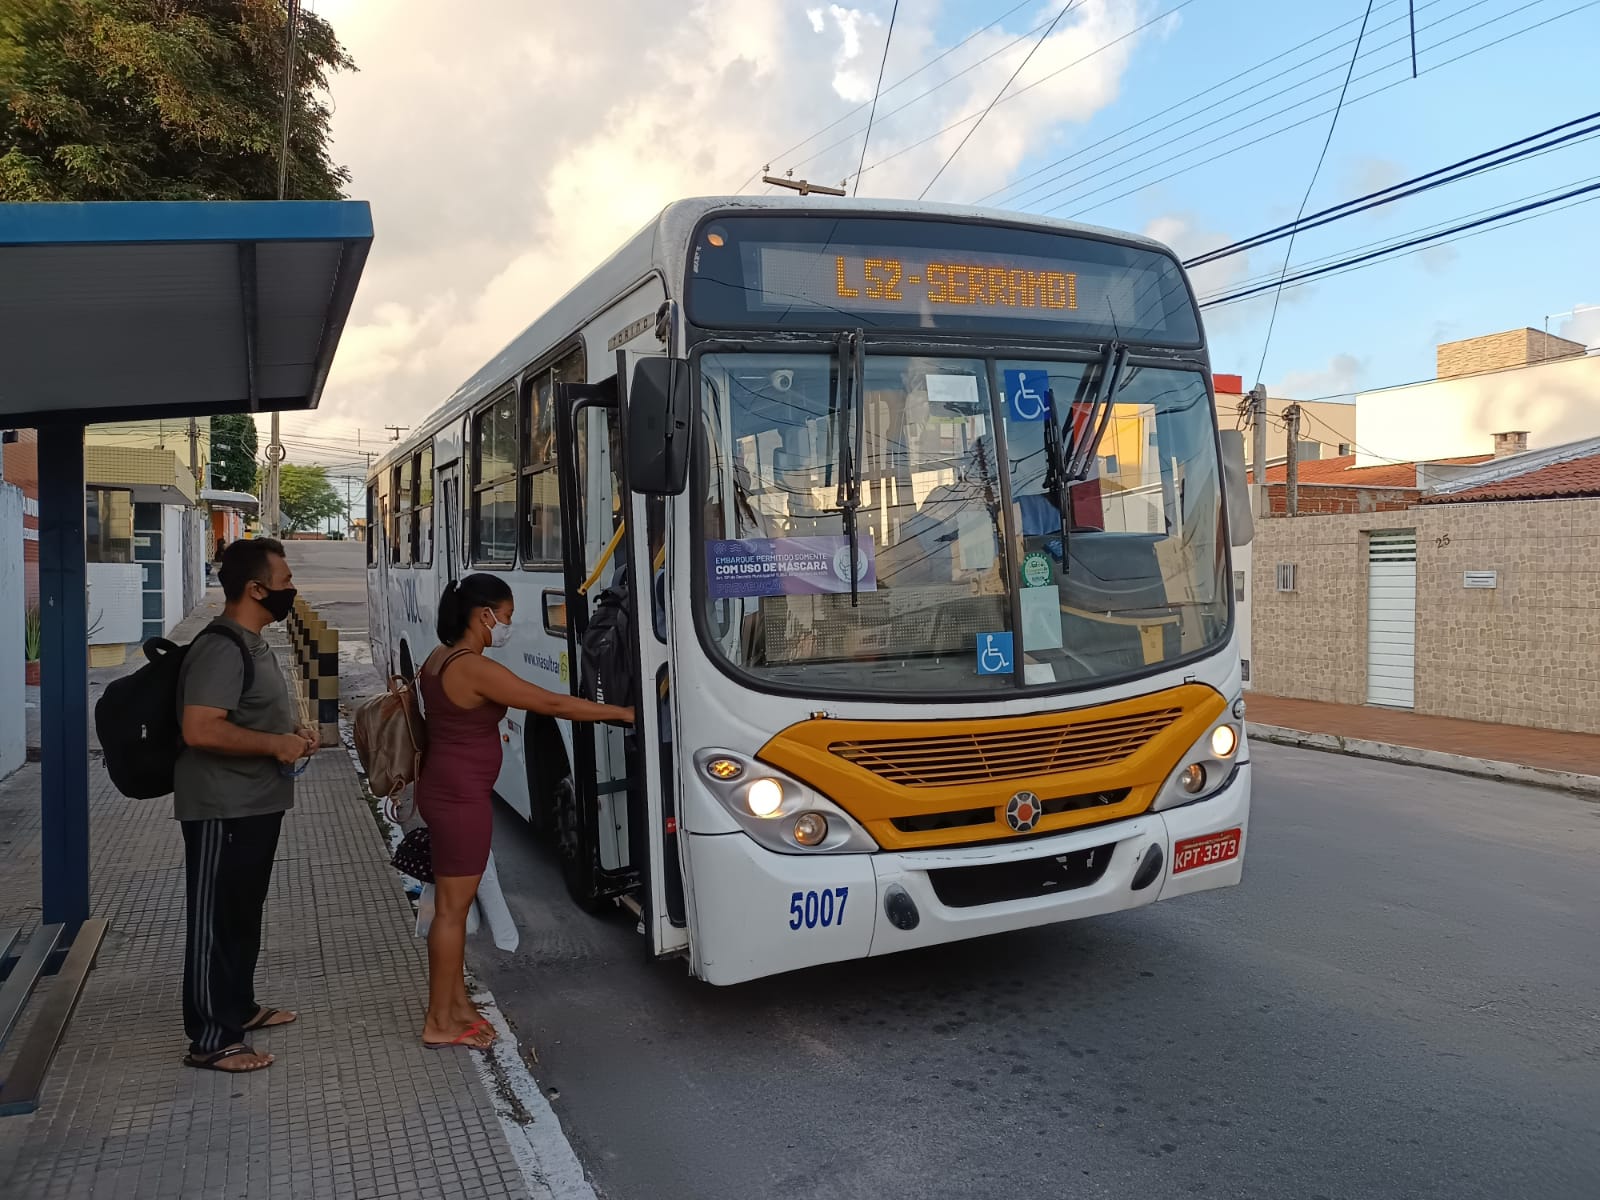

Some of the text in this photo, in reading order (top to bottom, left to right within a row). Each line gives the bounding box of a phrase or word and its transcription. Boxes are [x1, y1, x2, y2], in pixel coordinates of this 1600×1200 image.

[836, 256, 859, 298] L
[1435, 533, 1450, 549] 25
[715, 552, 828, 565] EMBARQUE PERMITIDO SOMENTE
[715, 564, 738, 575] COM
[740, 563, 761, 574] USO
[763, 562, 777, 573] DE
[778, 560, 828, 572] MÁSCARA
[789, 887, 848, 930] 5007
